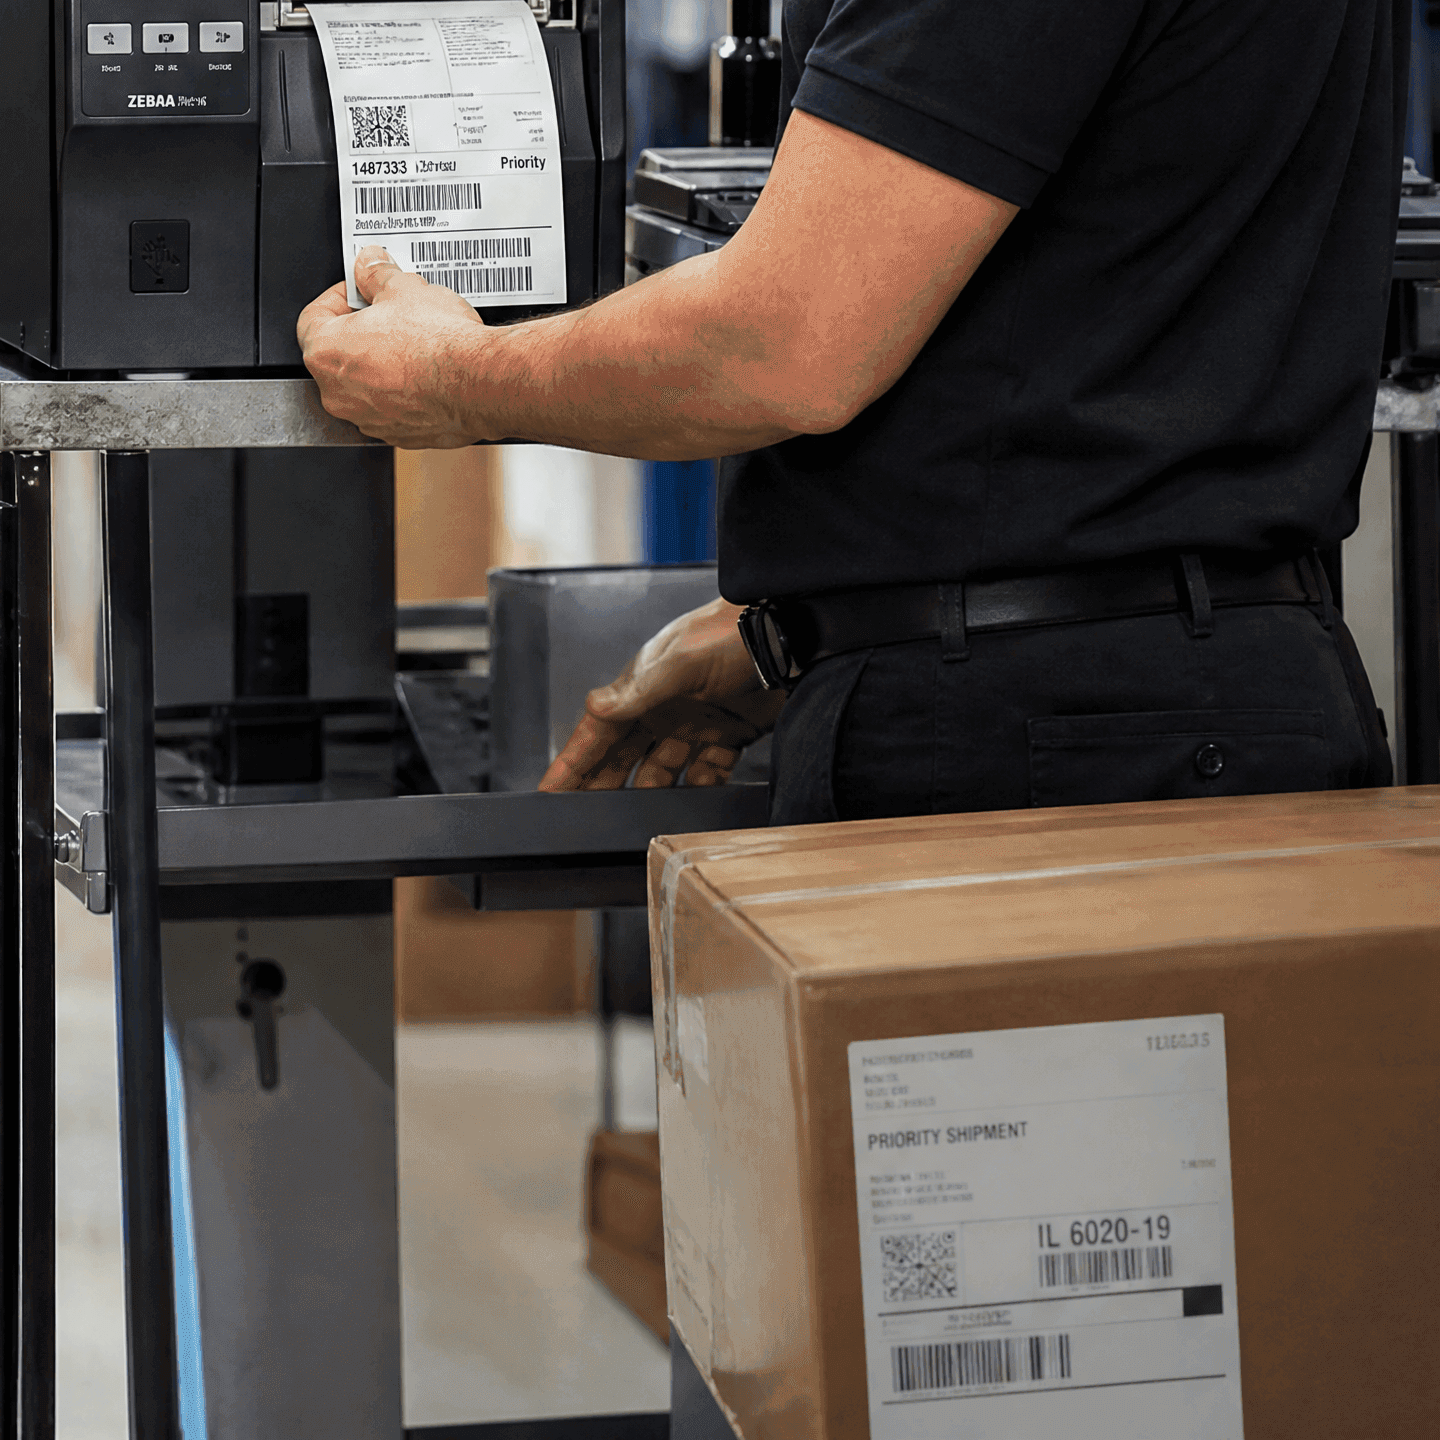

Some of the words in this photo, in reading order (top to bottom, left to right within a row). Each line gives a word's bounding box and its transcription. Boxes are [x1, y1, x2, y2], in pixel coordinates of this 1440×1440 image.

[127, 94, 176, 108] ZEBAA
[501, 156, 546, 171] Priority
[867, 1127, 941, 1151] PRIORITY
[946, 1121, 1028, 1144] SHIPMENT
[1038, 1223, 1060, 1248] IL
[1069, 1215, 1171, 1246] 6020-19
